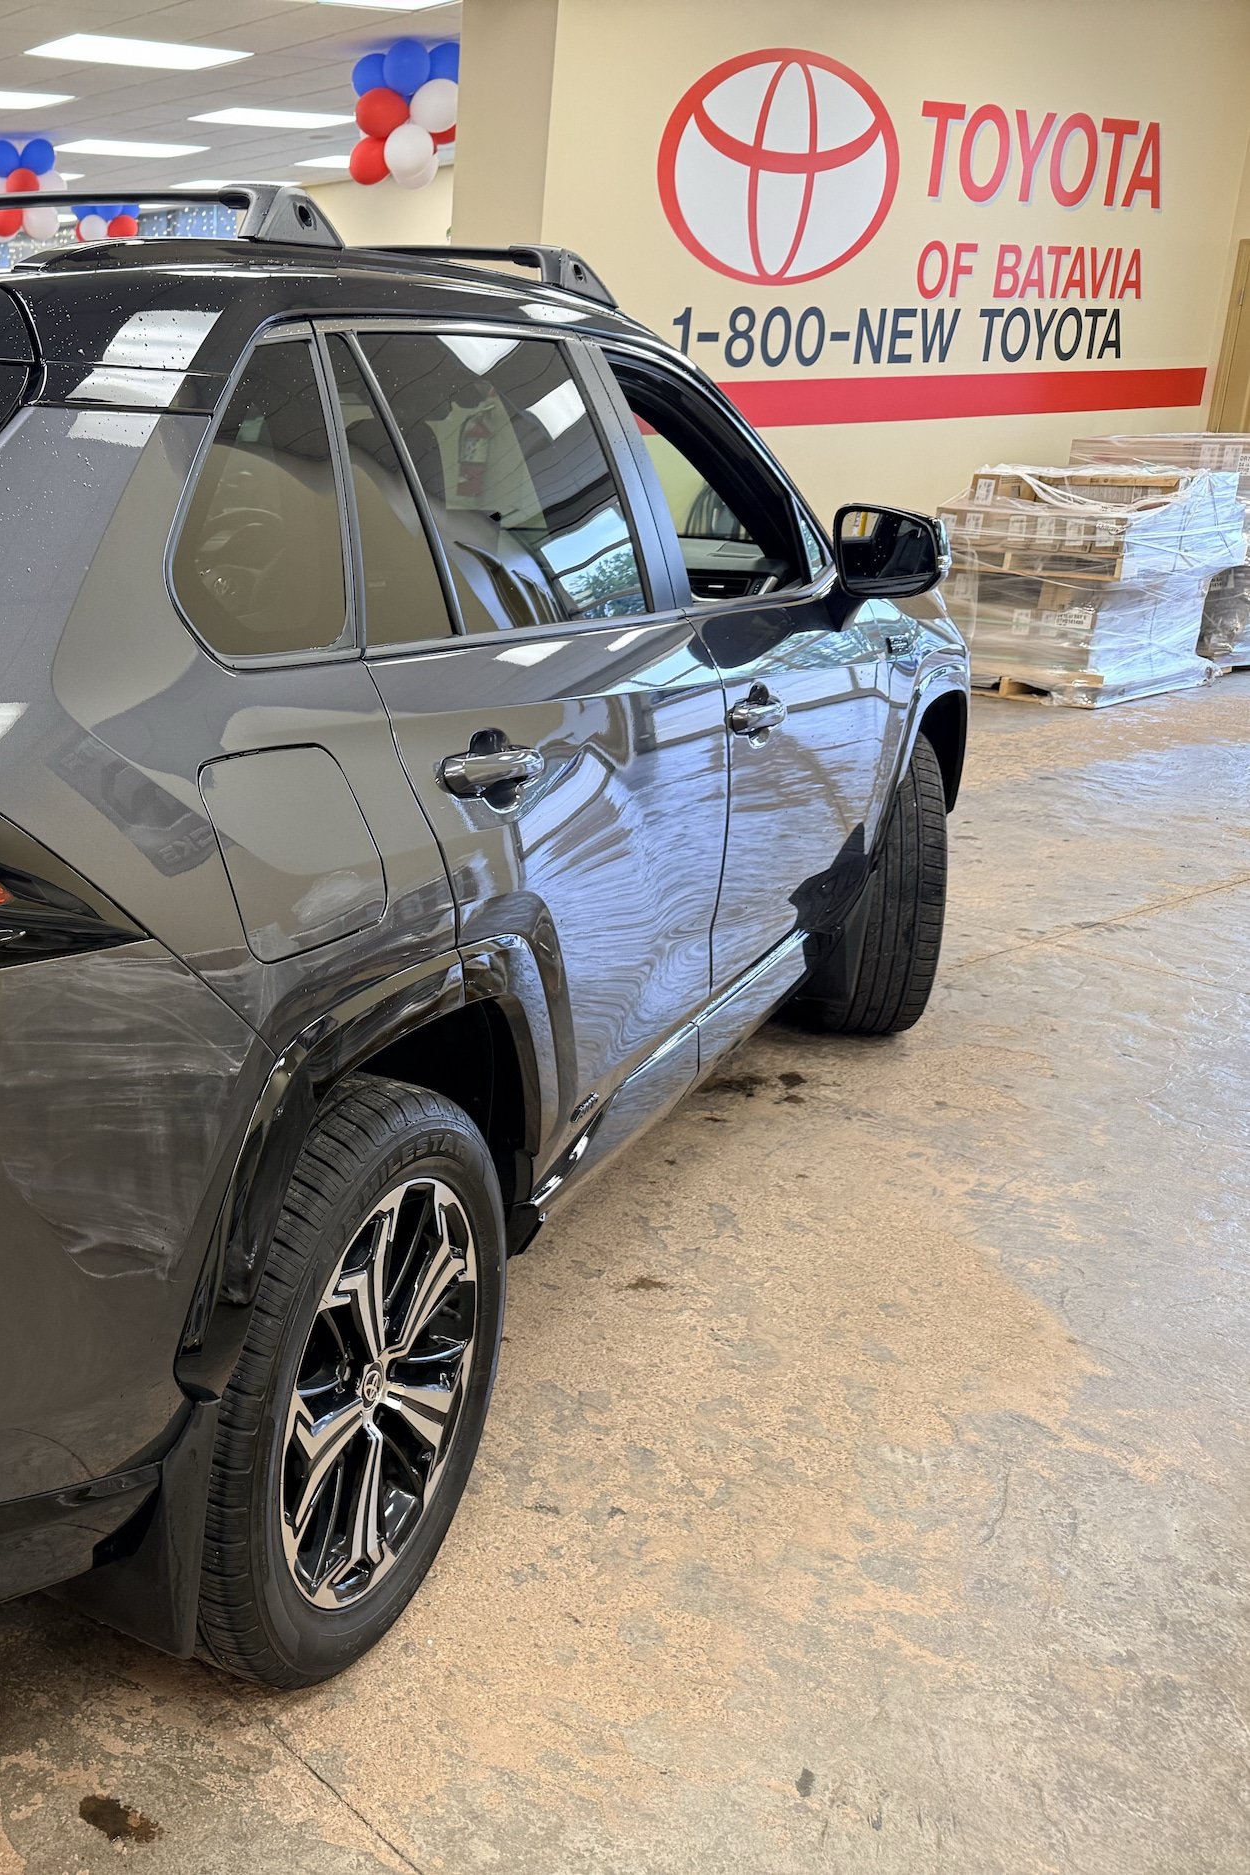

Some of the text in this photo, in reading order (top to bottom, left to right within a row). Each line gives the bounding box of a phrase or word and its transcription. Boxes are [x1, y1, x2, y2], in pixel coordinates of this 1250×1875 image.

[921, 100, 1161, 209] TOYOTA
[916, 240, 1142, 300] OF BATAVIA
[672, 306, 1121, 368] 1-800-NEW TOYOTA
